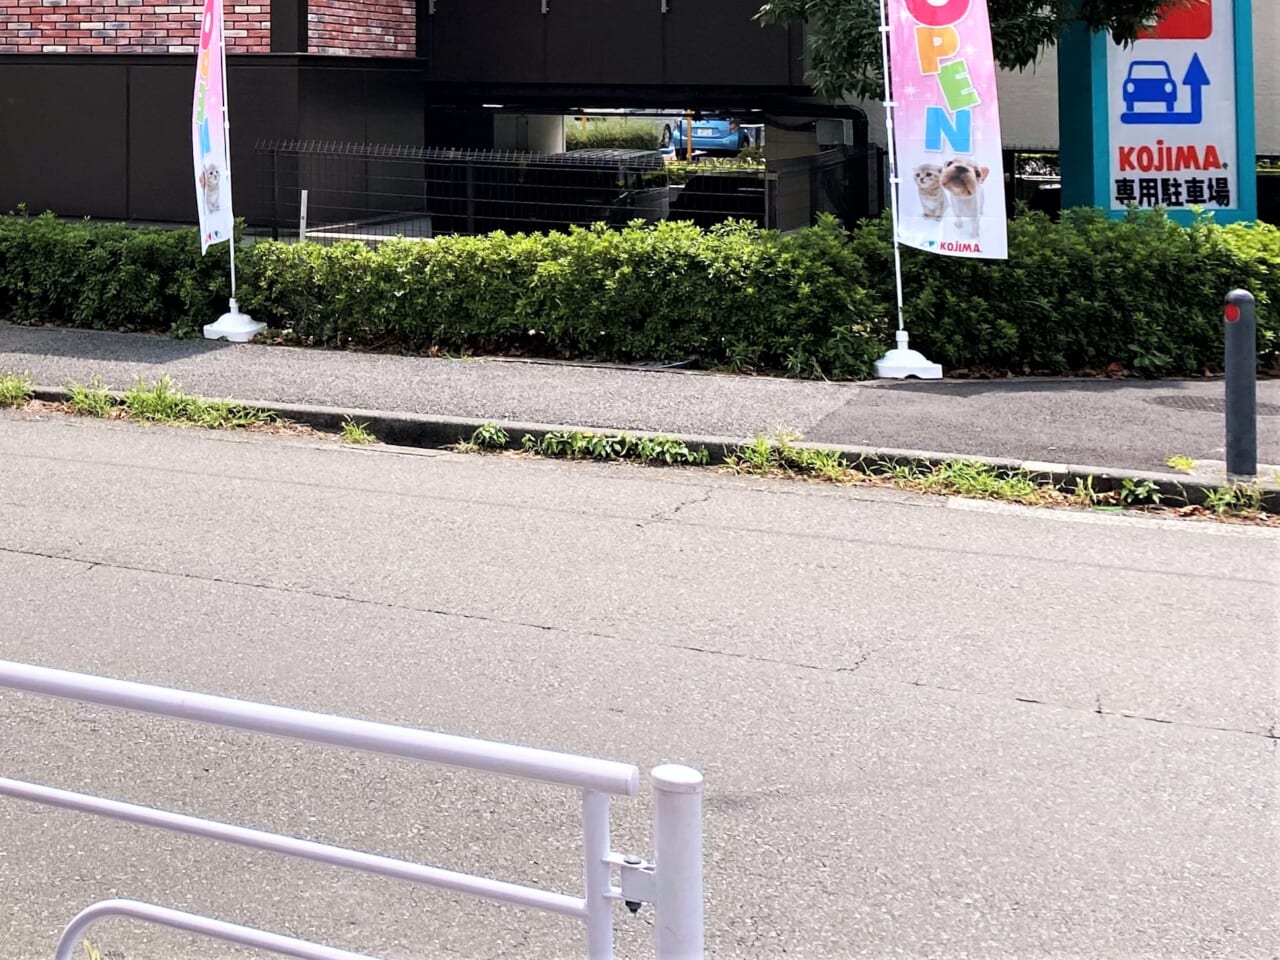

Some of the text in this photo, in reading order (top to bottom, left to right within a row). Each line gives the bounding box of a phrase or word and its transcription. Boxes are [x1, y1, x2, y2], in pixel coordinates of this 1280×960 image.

[1114, 177, 1230, 207] 専用駐車場
